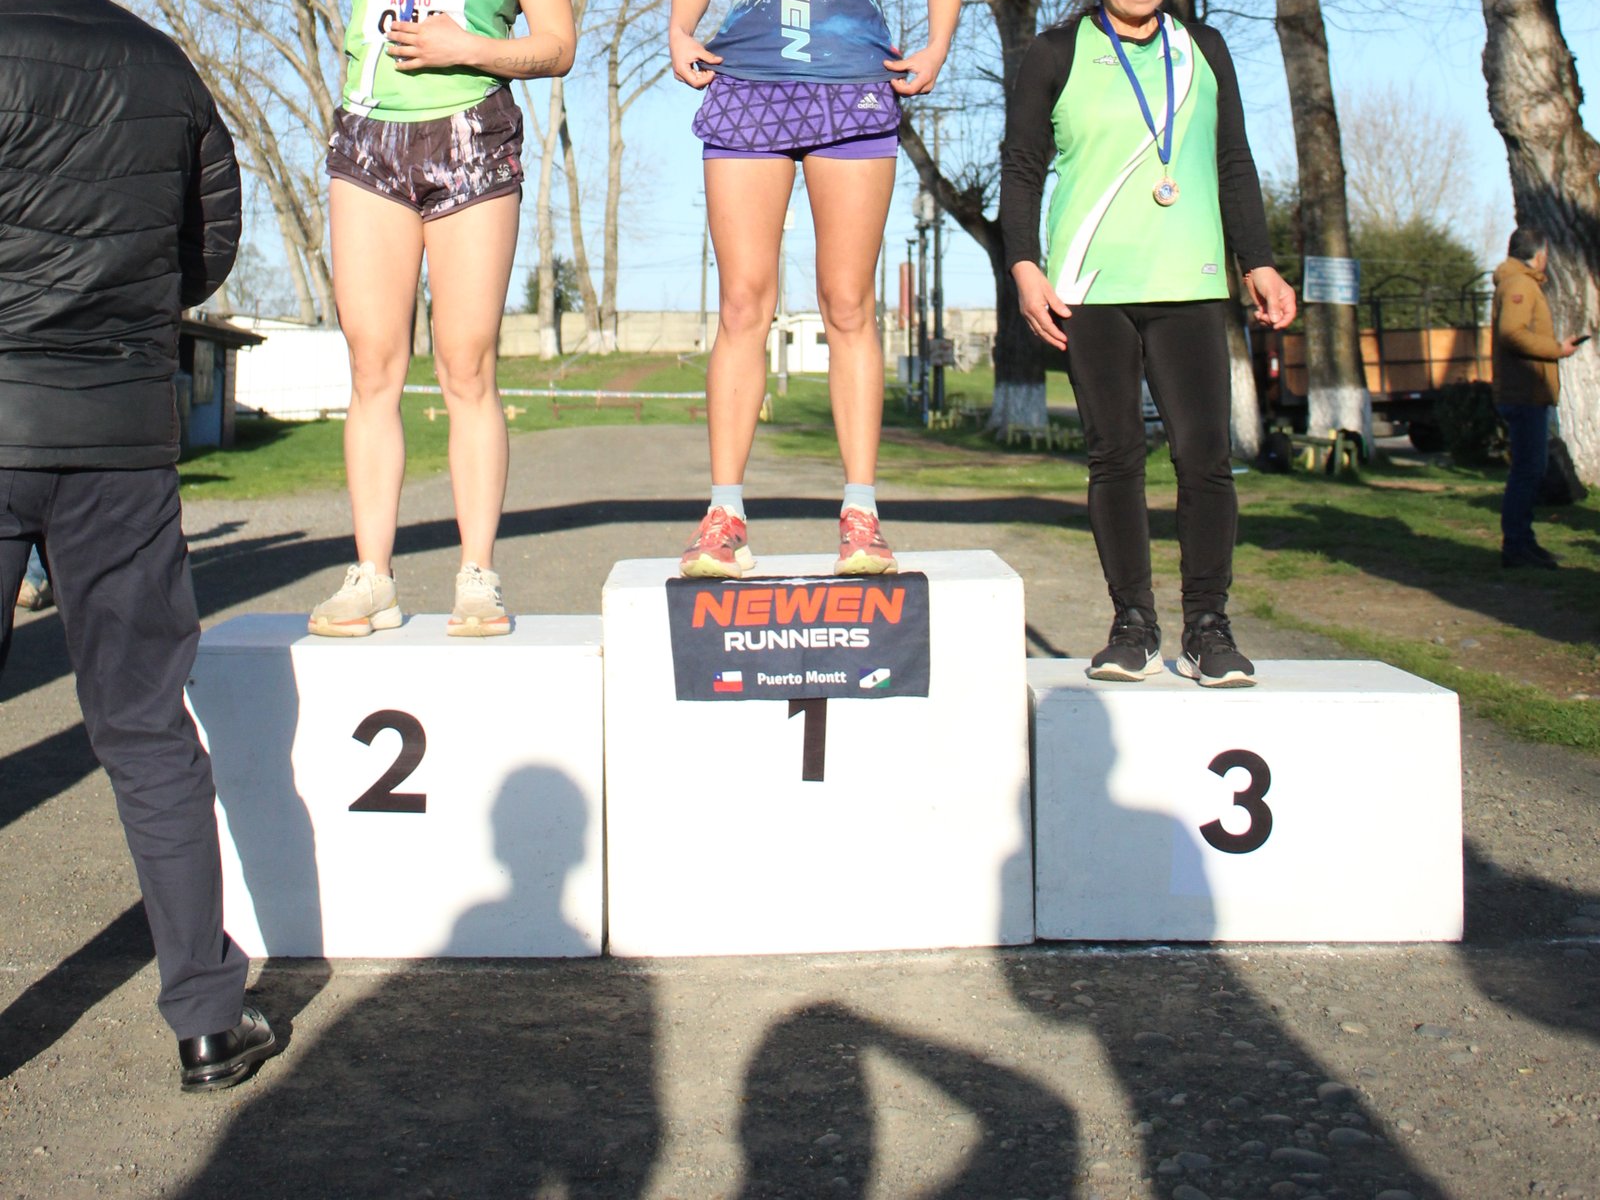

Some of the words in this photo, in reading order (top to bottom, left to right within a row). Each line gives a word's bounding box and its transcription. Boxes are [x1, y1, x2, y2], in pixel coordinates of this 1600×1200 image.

[691, 586, 906, 628] NEWEN
[724, 628, 870, 651] RUNNERS
[757, 672, 803, 686] Puerto
[805, 670, 848, 684] Montt
[348, 708, 427, 814] 2
[787, 697, 828, 783] 1
[1198, 748, 1273, 855] 3
